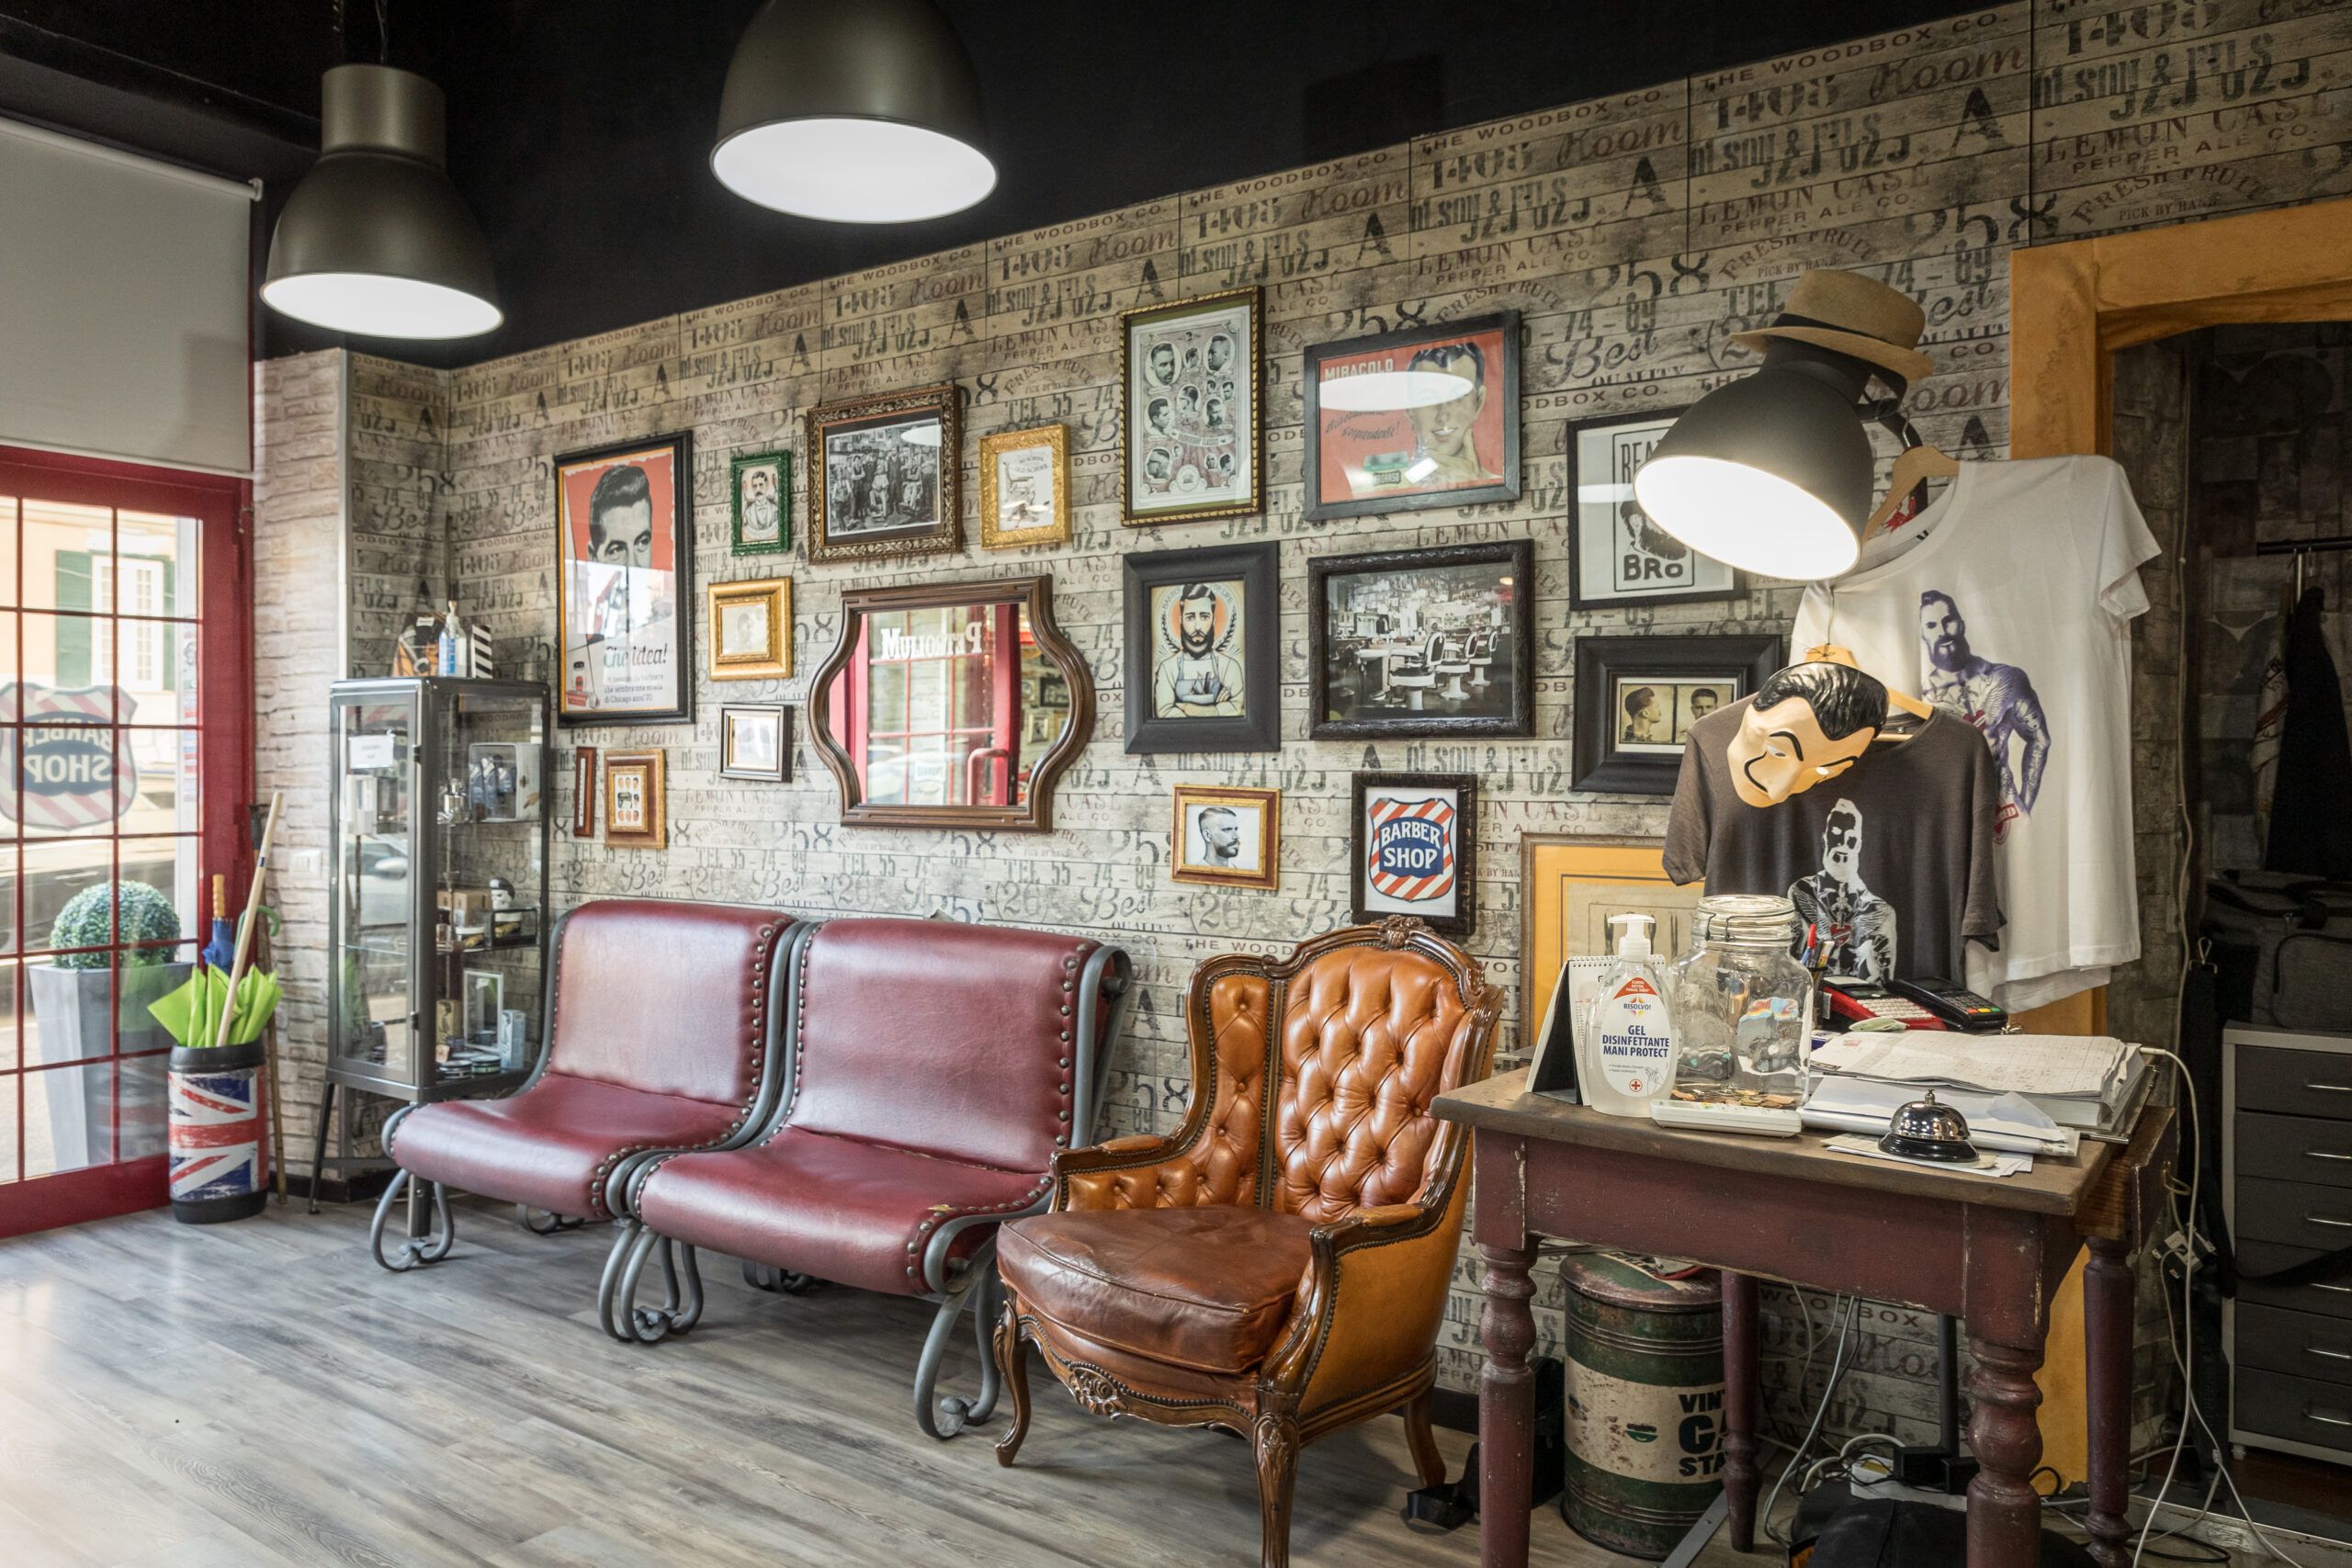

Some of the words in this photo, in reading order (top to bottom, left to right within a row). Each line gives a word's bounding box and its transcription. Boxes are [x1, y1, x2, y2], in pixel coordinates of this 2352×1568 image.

[1702, 69, 1754, 91] THE
[1772, 28, 1930, 73] WOODBOX
[1952, 14, 2008, 32] CO.
[1718, 75, 1838, 130] 1408
[1869, 48, 2025, 100] Room
[1421, 135, 1464, 154] THE
[1477, 102, 1608, 140] WOODBOX
[1624, 90, 1669, 107] CO.
[1951, 87, 2009, 155] A
[2043, 116, 2188, 164] LEMON
[2212, 92, 2335, 133] CASE
[1434, 142, 1532, 189] 1408
[1557, 120, 1683, 165] Room
[2072, 144, 2179, 174] PEPPER
[2196, 132, 2251, 154] ALE
[2267, 124, 2319, 141] CO.
[1189, 189, 1225, 207] THE
[1236, 162, 1344, 194] WOODBOX
[1357, 152, 1395, 168] CO.
[1623, 156, 1672, 217] A
[1701, 186, 1815, 227] LEMON
[1833, 164, 1928, 199] CASE
[2070, 170, 2174, 225] FRESH
[2183, 165, 2268, 200] FRUIT
[1198, 197, 1282, 239] 1408
[1301, 178, 1406, 220] Room
[1721, 211, 1806, 234] PEPPER
[1820, 201, 1863, 219] ALE
[1877, 193, 1916, 208] CO.
[2119, 207, 2150, 221] PICK
[2155, 203, 2177, 217] BY
[994, 236, 1024, 252] THE
[1033, 213, 1125, 241] WOODBOX
[1136, 205, 1167, 218] CO.
[1357, 212, 1394, 266] A
[1088, 230, 1176, 265] Room
[1419, 242, 1511, 275] LEMON
[1528, 220, 1606, 254] CASE
[1719, 231, 1803, 280] FRESH
[1808, 229, 1878, 262] FRUIT
[829, 277, 854, 291] THE
[863, 257, 940, 280] WOODBOX
[949, 250, 976, 261] CO.
[1136, 258, 1166, 303] A
[1276, 270, 1343, 299] CASE
[1436, 265, 1507, 284] PEPPER
[1518, 256, 1552, 271] ALE
[715, 294, 782, 316] WOODBOX
[1268, 302, 1297, 314] ALE
[1505, 281, 1563, 310] FRUIT
[1722, 281, 1785, 317] TEL
[587, 327, 647, 346] WOODBOX
[950, 299, 978, 340] A
[790, 333, 812, 372] A
[992, 327, 1057, 353] LEMON
[1004, 344, 1054, 360] PEPPER
[1061, 339, 1084, 351] ALE
[1545, 325, 1658, 384] Best
[1951, 341, 2006, 359] CO.
[1324, 358, 1394, 381] MIRACOLO
[1005, 397, 1042, 423] TEL
[1521, 392, 1607, 412] ODBOX
[1623, 384, 1668, 400] CO.
[1415, 521, 1510, 547] LEMON
[632, 643, 667, 666] idea!
[1523, 798, 1602, 822] CASE
[1381, 821, 1441, 850] BARBER
[1384, 847, 1438, 869] SHOP
[1080, 886, 1157, 923] Best
[1182, 938, 1220, 951] THE
[1231, 942, 1294, 956] WOOD
[1132, 988, 1161, 1032] A
[1623, 1002, 1652, 1010] RISOLVO!
[1602, 1035, 1669, 1047] DISINFETTANTE
[1628, 1025, 1645, 1035] GEL
[1603, 1047, 1628, 1055] MANI
[1630, 1047, 1668, 1057] PROTECT
[1679, 1389, 1725, 1413] VIN
[1679, 1456, 1726, 1477] STA
